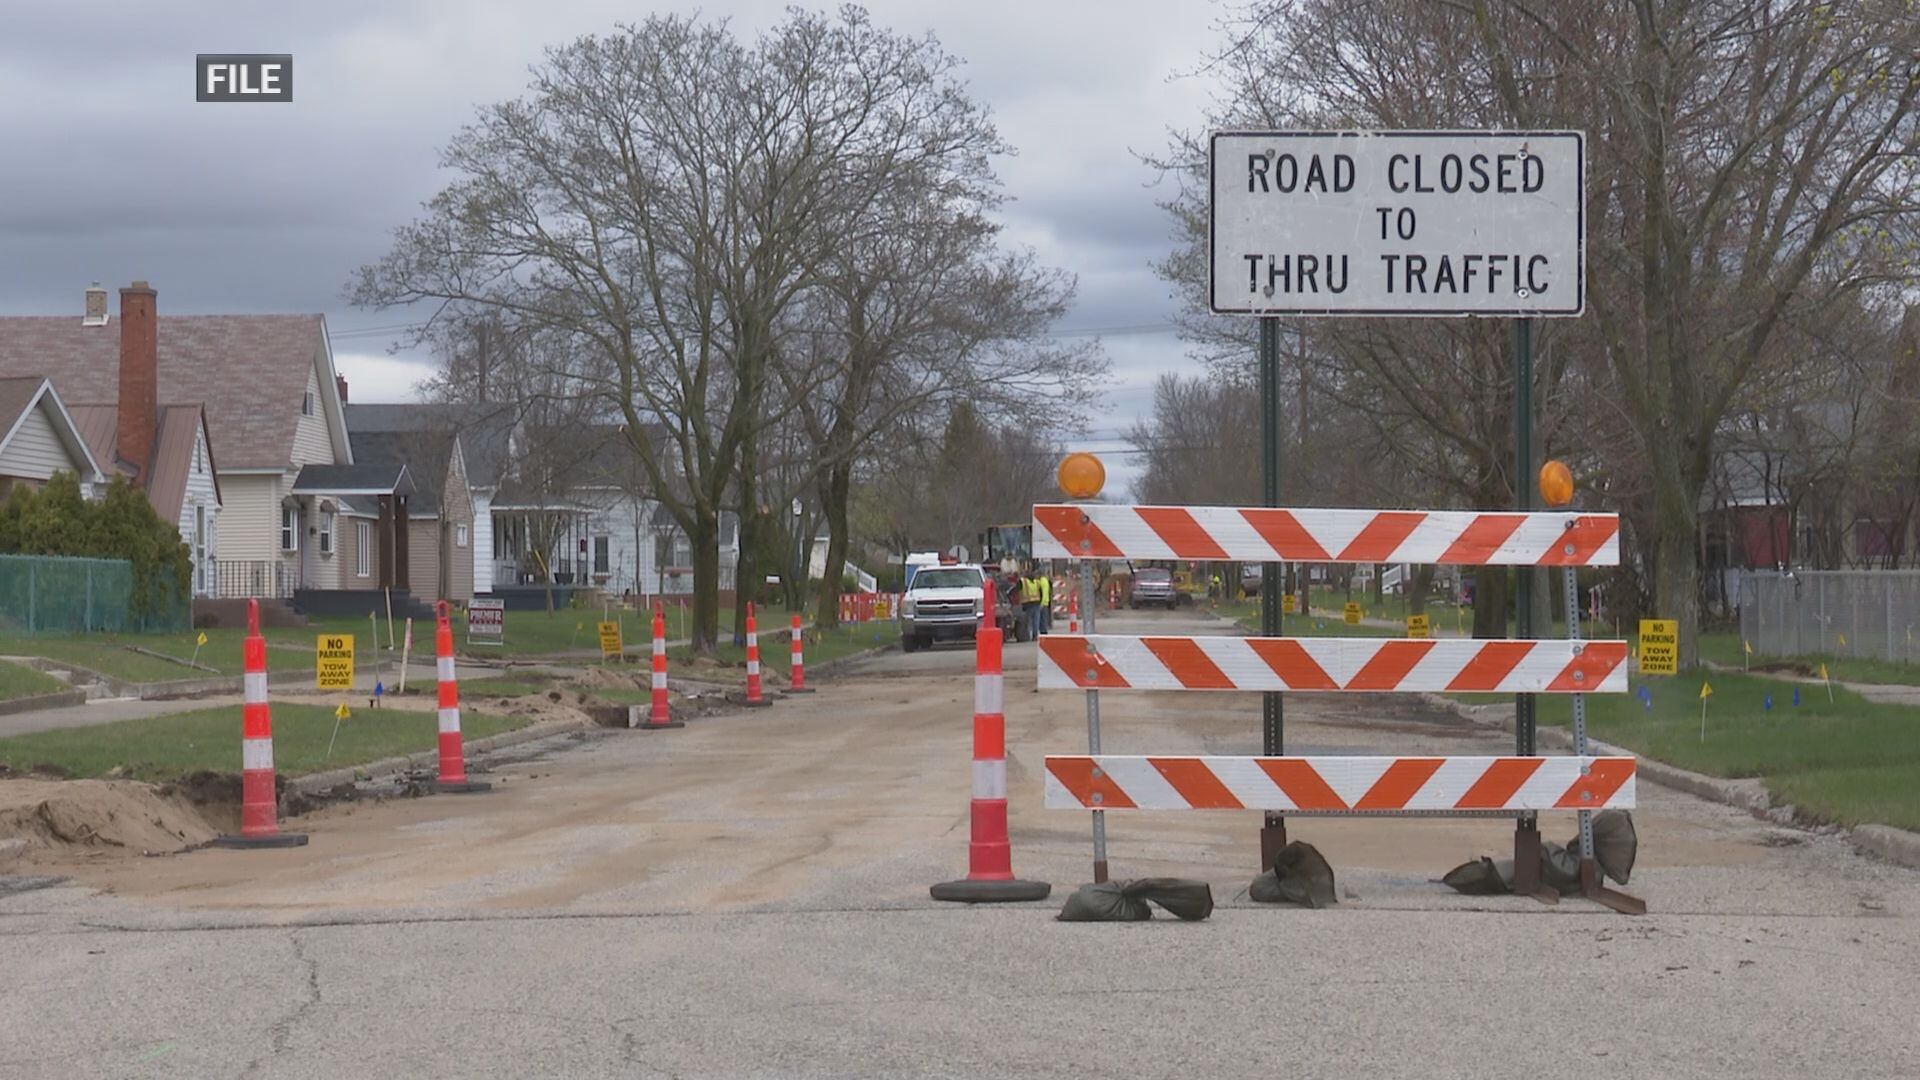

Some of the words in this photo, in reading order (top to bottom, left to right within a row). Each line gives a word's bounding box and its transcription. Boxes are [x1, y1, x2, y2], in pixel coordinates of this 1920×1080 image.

[1248, 153, 1355, 193] ROAD
[1388, 153, 1544, 193] CLOSED
[1376, 207, 1416, 240] TO
[1244, 254, 1349, 293] THRU
[1381, 254, 1549, 294] TRAFFIC
[1652, 623, 1664, 632] NO
[327, 638, 343, 649] NO
[1641, 634, 1675, 644] PARKING
[319, 650, 352, 659] PARKING
[323, 663, 348, 671] TOW
[1642, 663, 1673, 671] ZONE
[320, 678, 350, 686] ZONE
